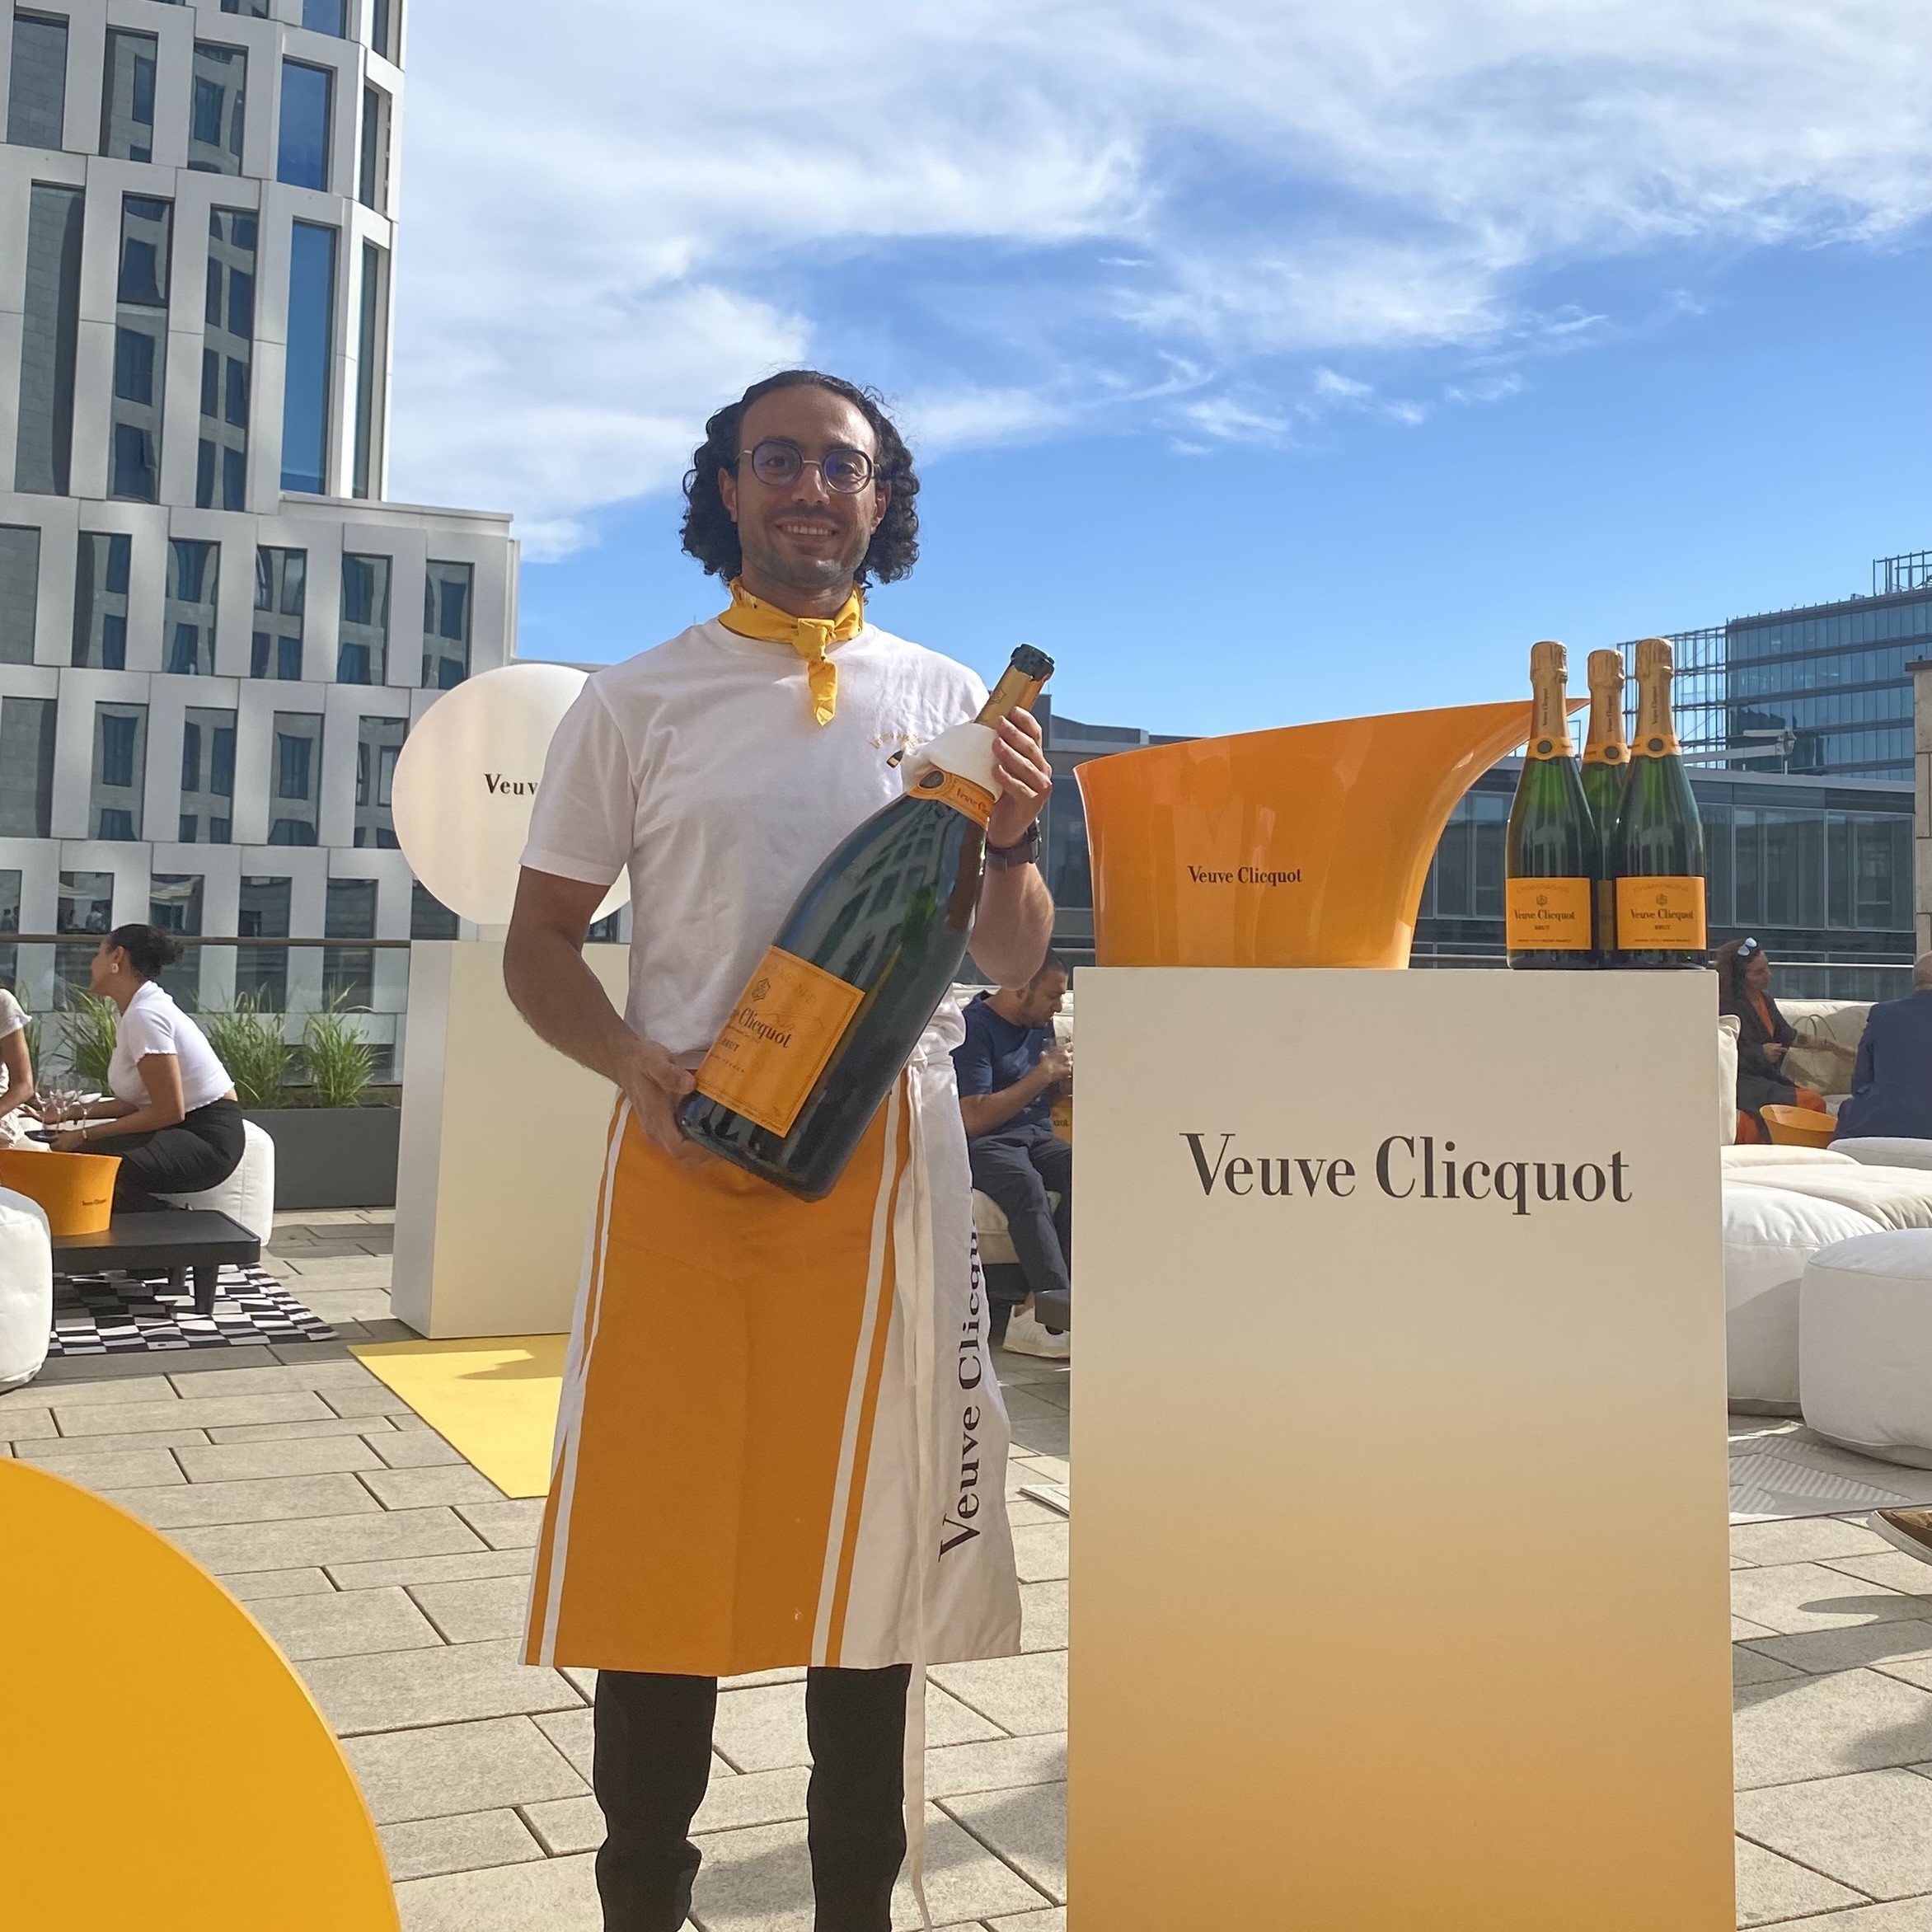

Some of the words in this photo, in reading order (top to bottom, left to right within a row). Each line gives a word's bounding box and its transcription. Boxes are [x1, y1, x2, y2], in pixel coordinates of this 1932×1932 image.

[1187, 865, 1234, 884] Veuve
[1238, 866, 1303, 887] Clicquot
[1514, 909, 1536, 920] Veuve
[1537, 909, 1575, 921] Clicquot
[1630, 909, 1656, 920] Veuve
[1658, 908, 1694, 921] Clicquot
[738, 1007, 792, 1048] Clicquot
[1179, 1132, 1356, 1198] Veuve
[1376, 1135, 1633, 1216] Clicquot
[959, 1218, 982, 1390] Clicqu
[938, 1404, 982, 1562] Veuve
